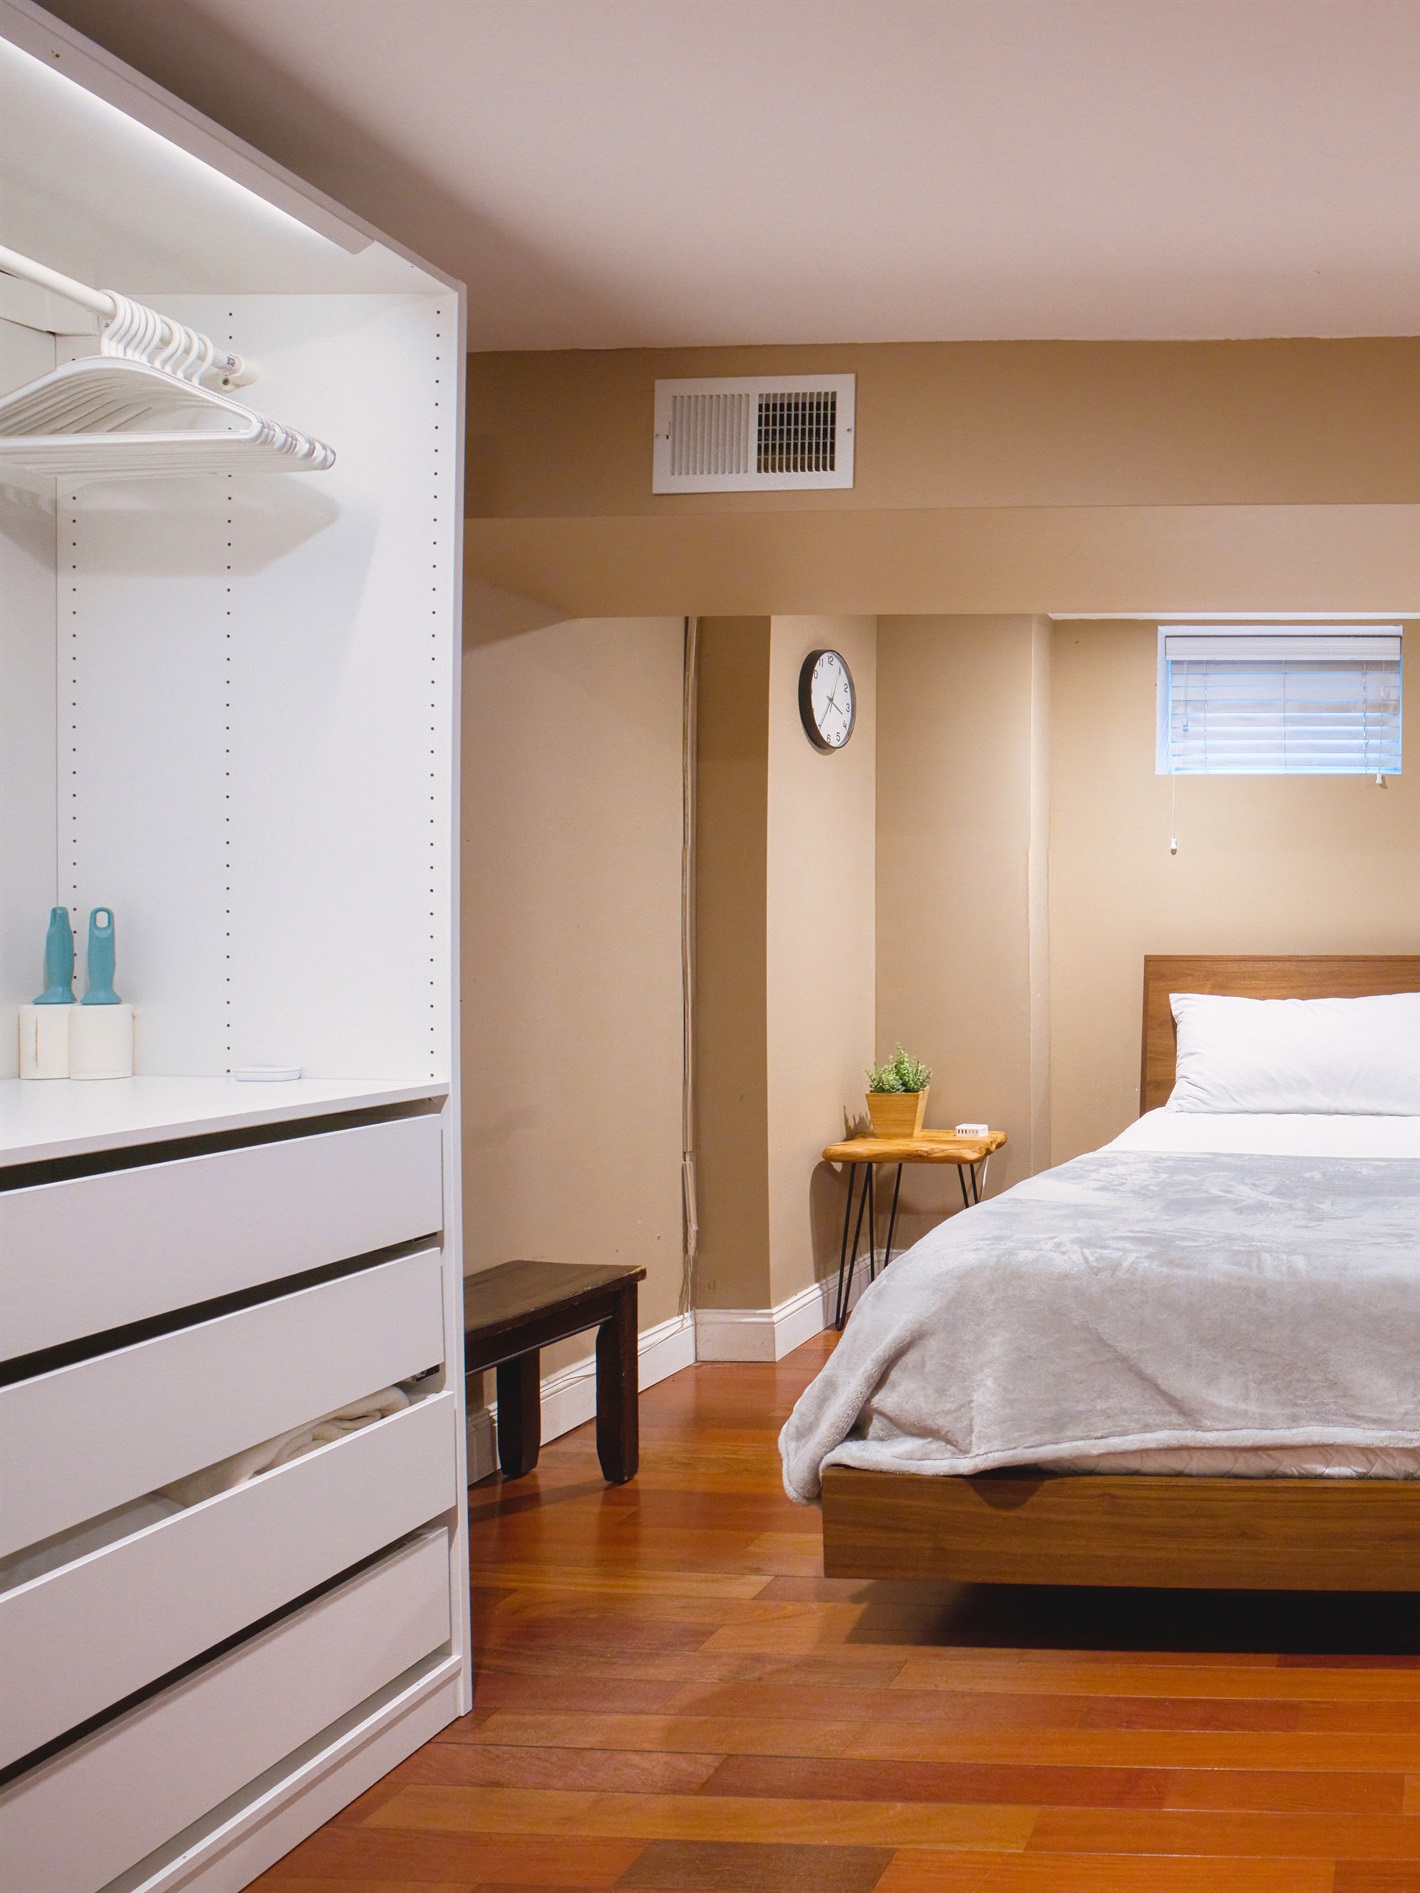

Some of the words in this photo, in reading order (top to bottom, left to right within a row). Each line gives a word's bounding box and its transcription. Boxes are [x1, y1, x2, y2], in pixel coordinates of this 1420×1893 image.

[828, 655, 834, 666] 12
[844, 682, 848, 693] 2
[846, 702, 850, 712] 3
[842, 720, 848, 730] 4
[826, 734, 832, 744] 6
[836, 732, 840, 742] 5
